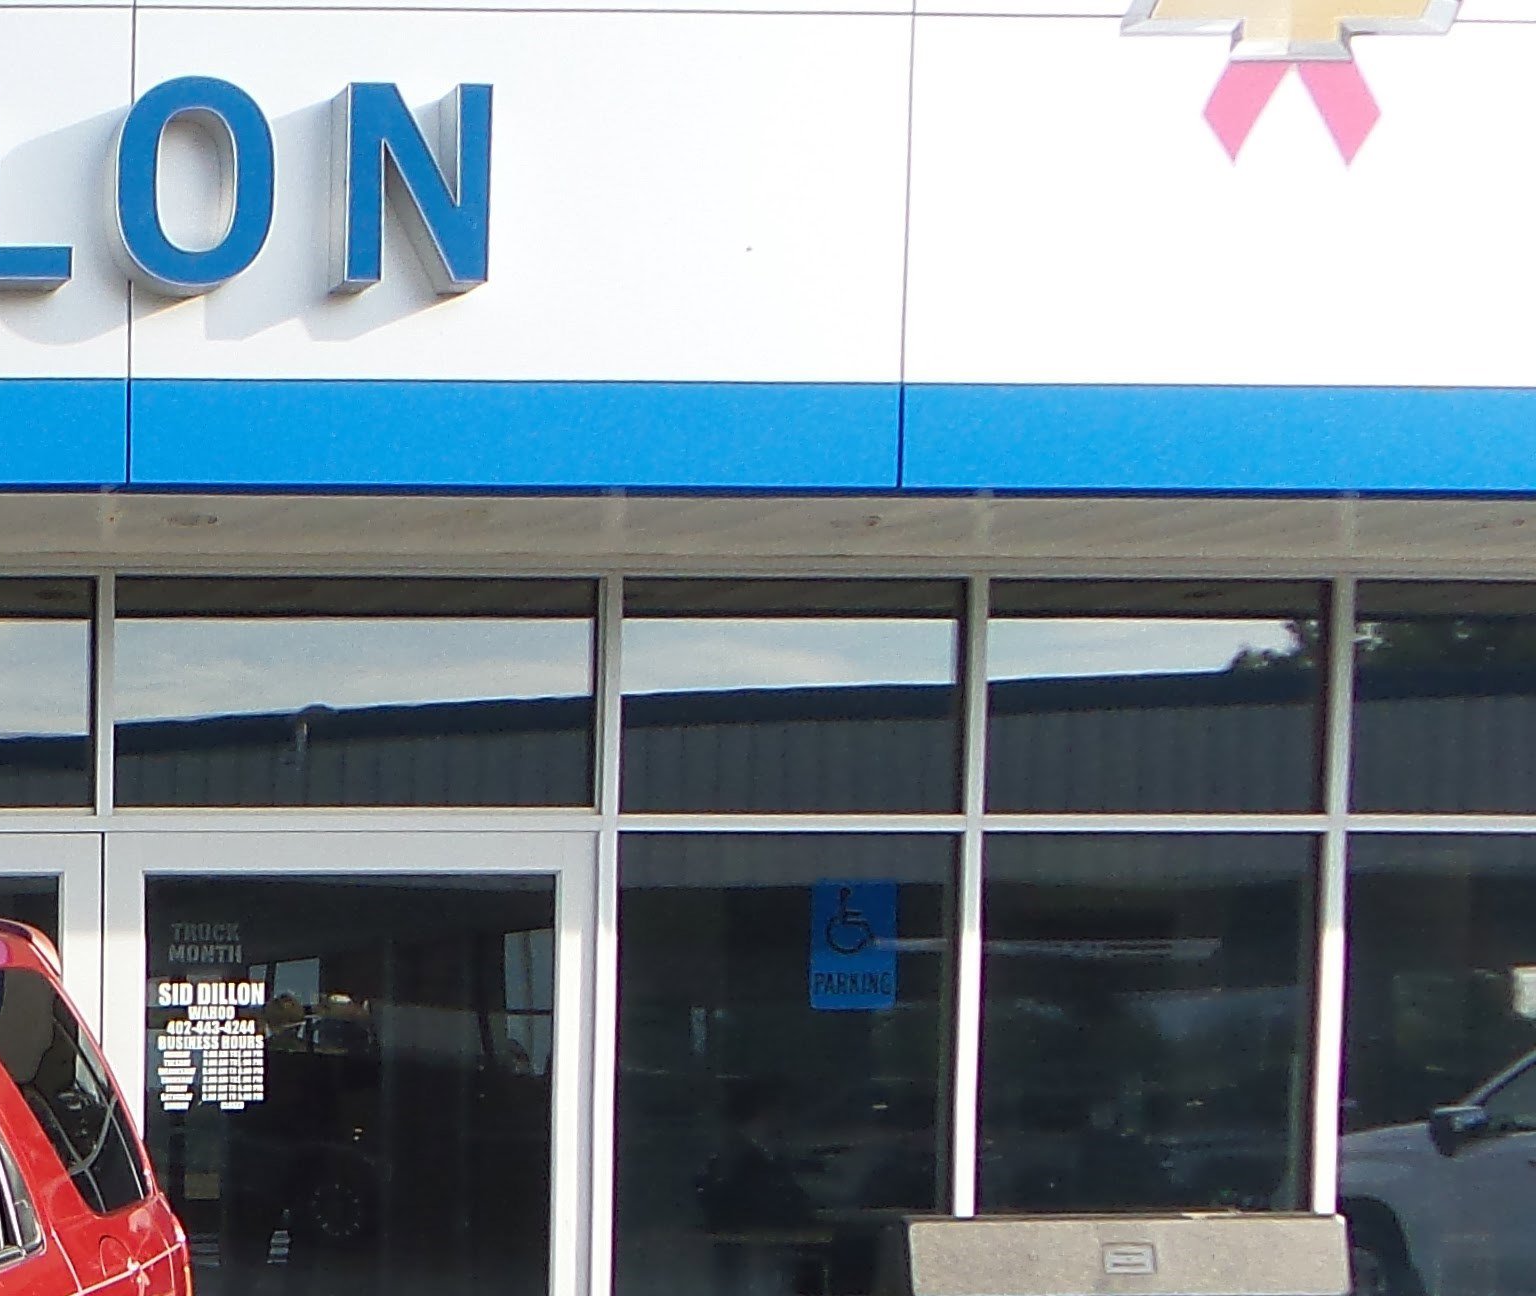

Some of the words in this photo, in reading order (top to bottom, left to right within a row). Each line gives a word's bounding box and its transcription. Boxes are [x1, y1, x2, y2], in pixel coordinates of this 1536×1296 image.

[171, 922, 240, 941] TRUCK
[169, 944, 243, 963] MONTH
[814, 971, 893, 995] PARKING
[158, 982, 193, 1006] SID
[196, 982, 265, 1006] DILLON
[188, 1006, 235, 1020] WAHOO
[166, 1020, 255, 1035] 402-443-4244
[157, 1035, 219, 1050] BUSINESS
[221, 1035, 264, 1050] HOURS
